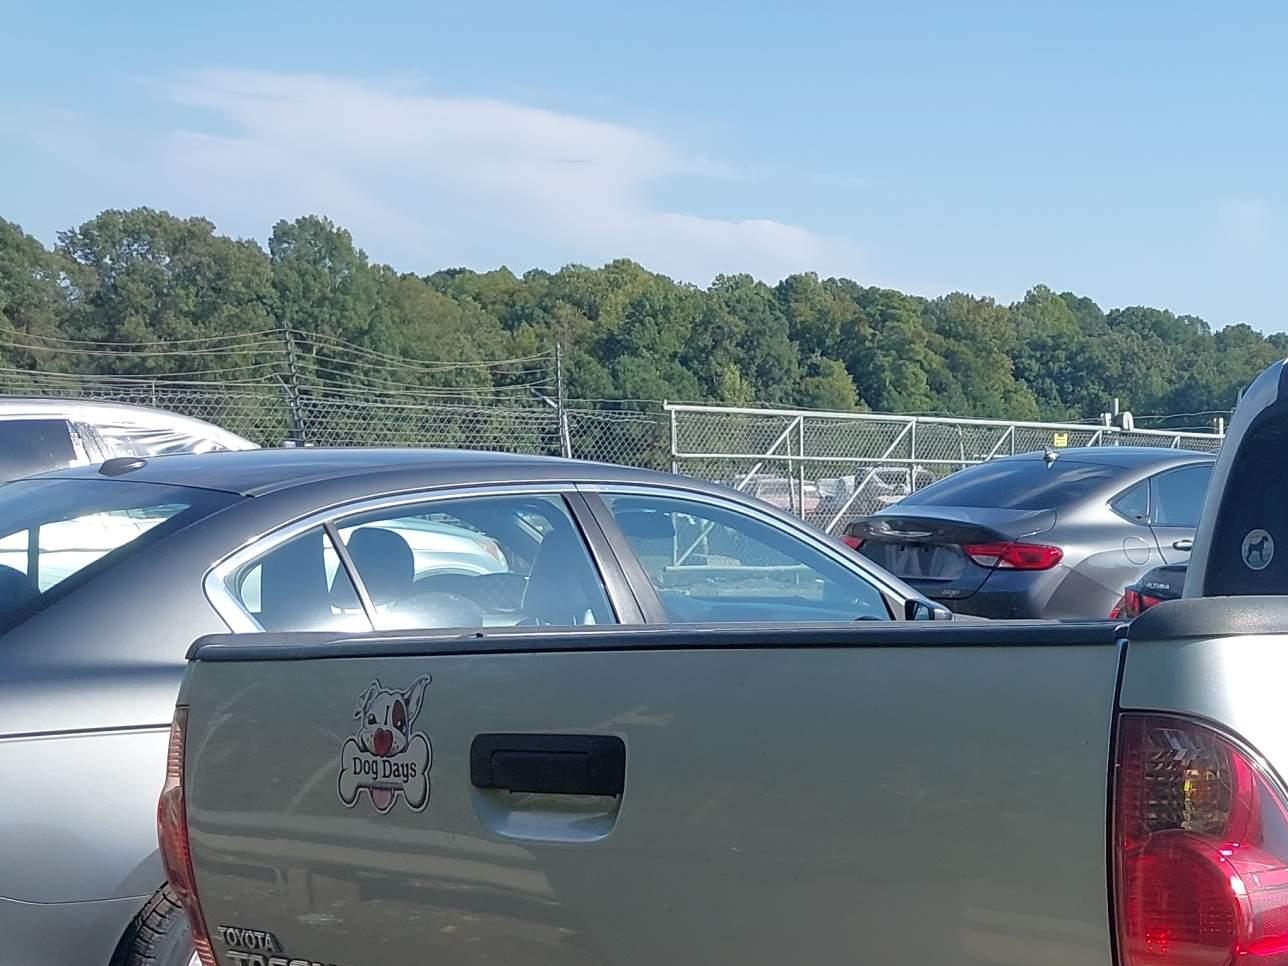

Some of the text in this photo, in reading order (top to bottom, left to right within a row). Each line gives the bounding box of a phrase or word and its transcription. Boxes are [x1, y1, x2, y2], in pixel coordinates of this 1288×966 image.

[353, 757, 417, 783] Dog Days
[217, 925, 283, 953] TOYOTA
